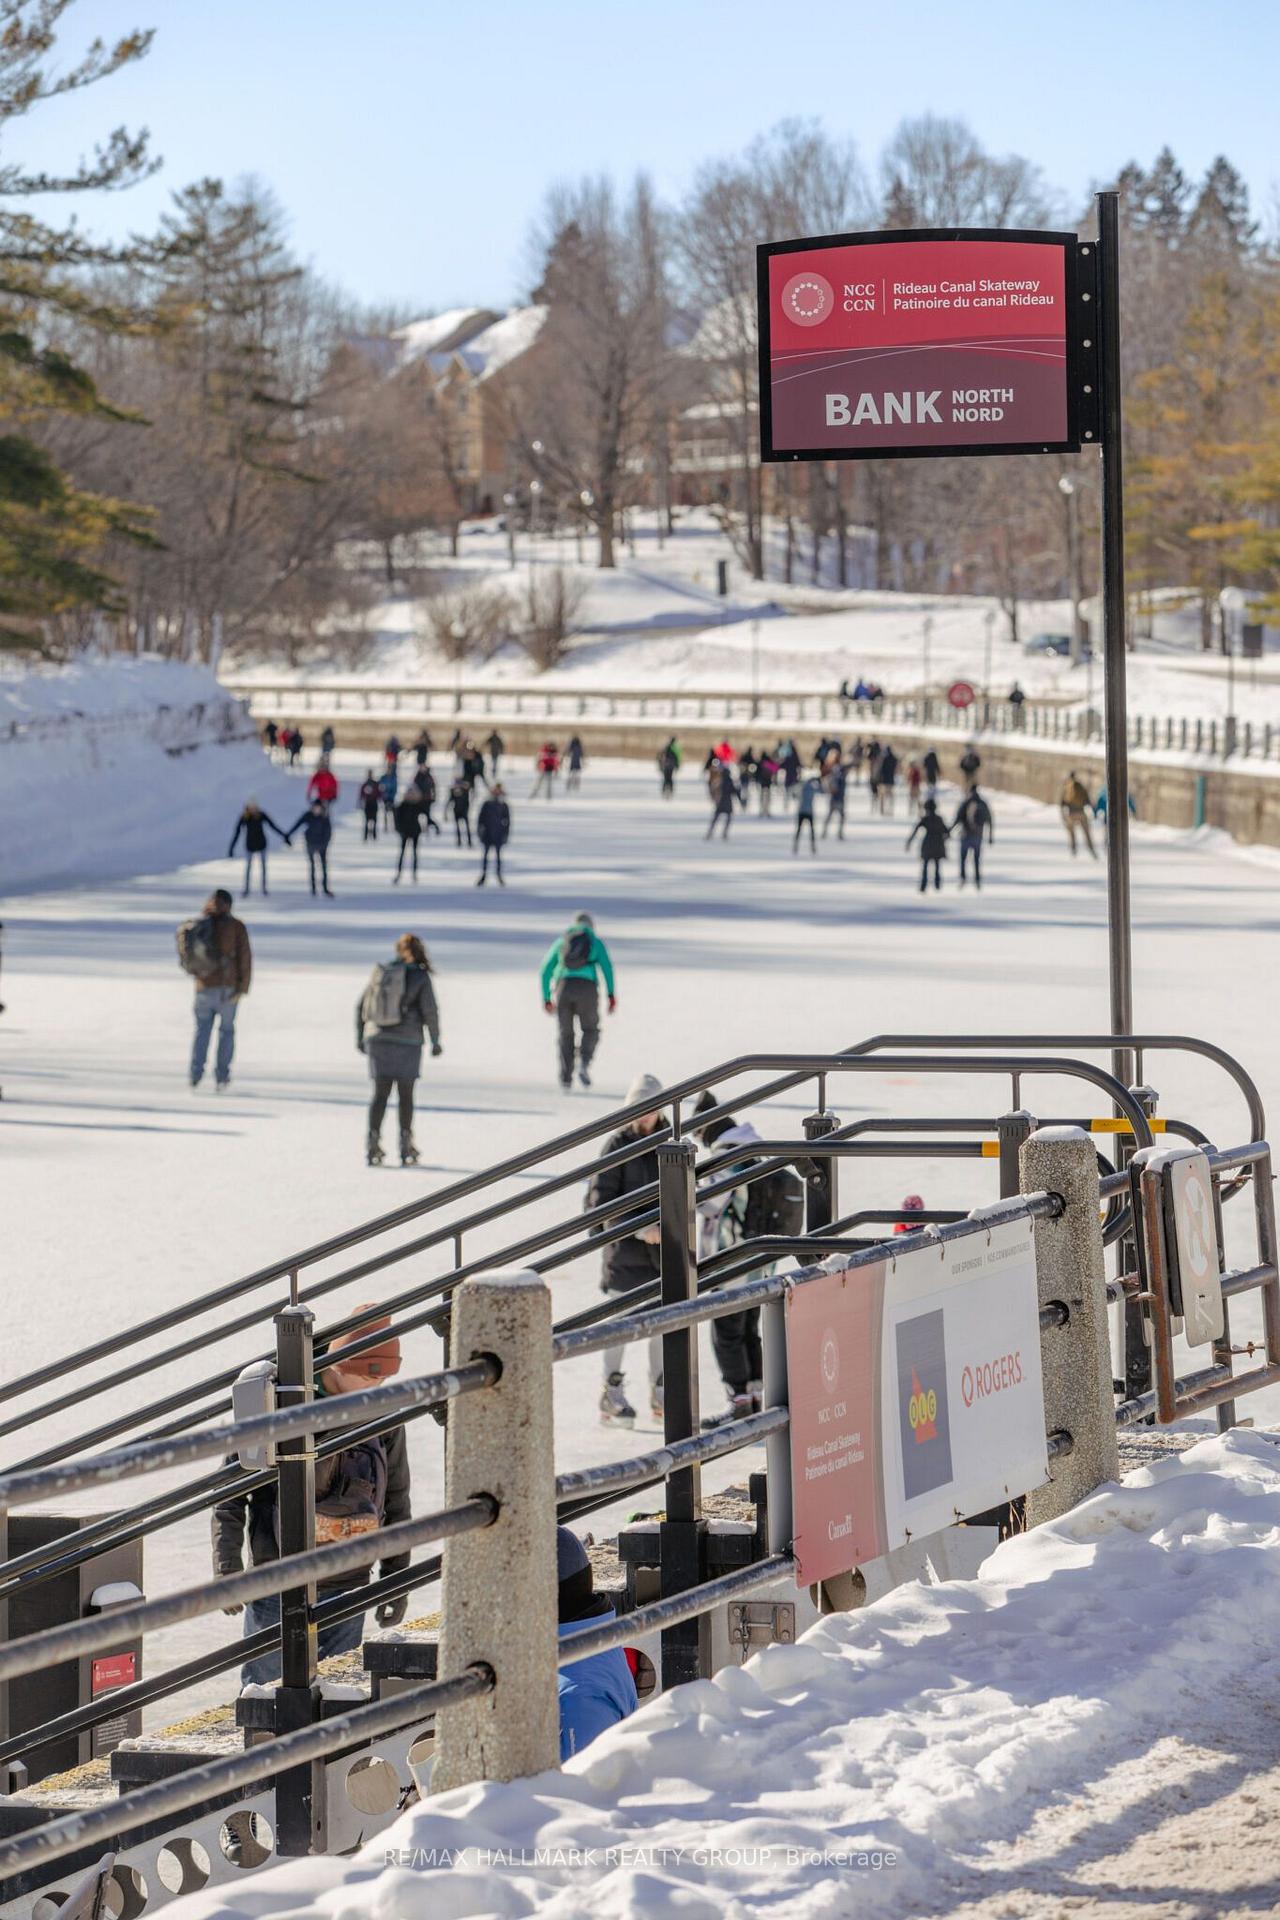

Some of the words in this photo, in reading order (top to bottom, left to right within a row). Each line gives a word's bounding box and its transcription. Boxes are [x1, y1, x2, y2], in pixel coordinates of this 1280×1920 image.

[843, 284, 875, 296] NCC
[893, 283, 937, 294] Rideau
[940, 280, 976, 293] Canal
[979, 280, 1040, 292] Skateway
[843, 300, 875, 311] CCN
[893, 297, 950, 310] Patinoire
[953, 296, 970, 308] du
[973, 295, 1007, 307] canal
[1010, 294, 1054, 306] Rideau
[952, 388, 1014, 404] NORTH
[825, 390, 943, 426] BANK
[952, 407, 1004, 423] NORD
[976, 1351, 1022, 1399] ROGERS
